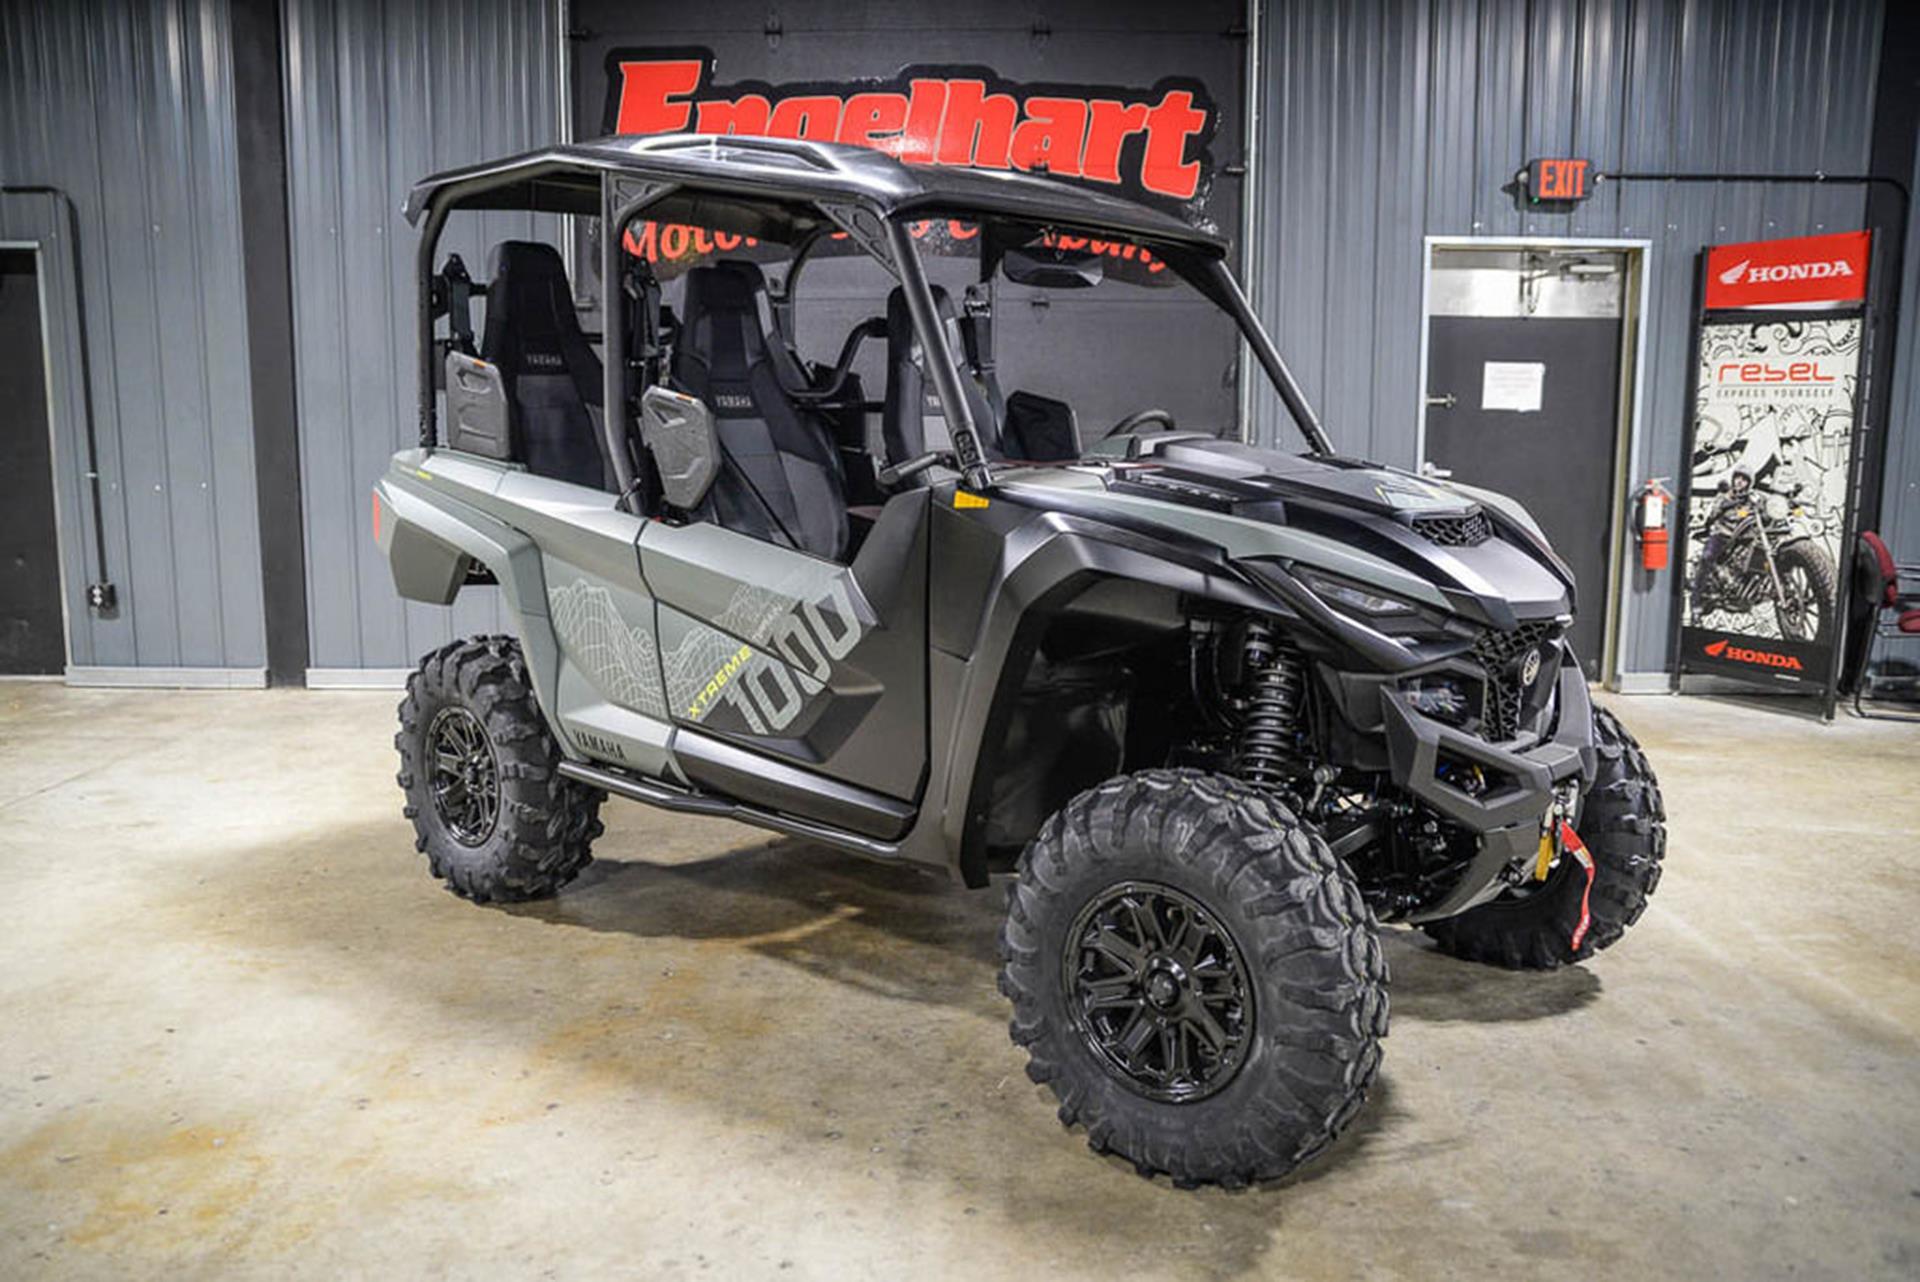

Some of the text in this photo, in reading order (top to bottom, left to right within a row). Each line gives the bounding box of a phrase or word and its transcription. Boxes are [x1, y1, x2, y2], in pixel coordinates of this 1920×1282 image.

[1539, 159, 1588, 199] EXIT
[1747, 260, 1854, 284] HONDA
[722, 574, 863, 736] 1000
[1725, 646, 1804, 671] HONDA
[687, 643, 753, 721] XTREME
[572, 728, 627, 760] YAMAHA
